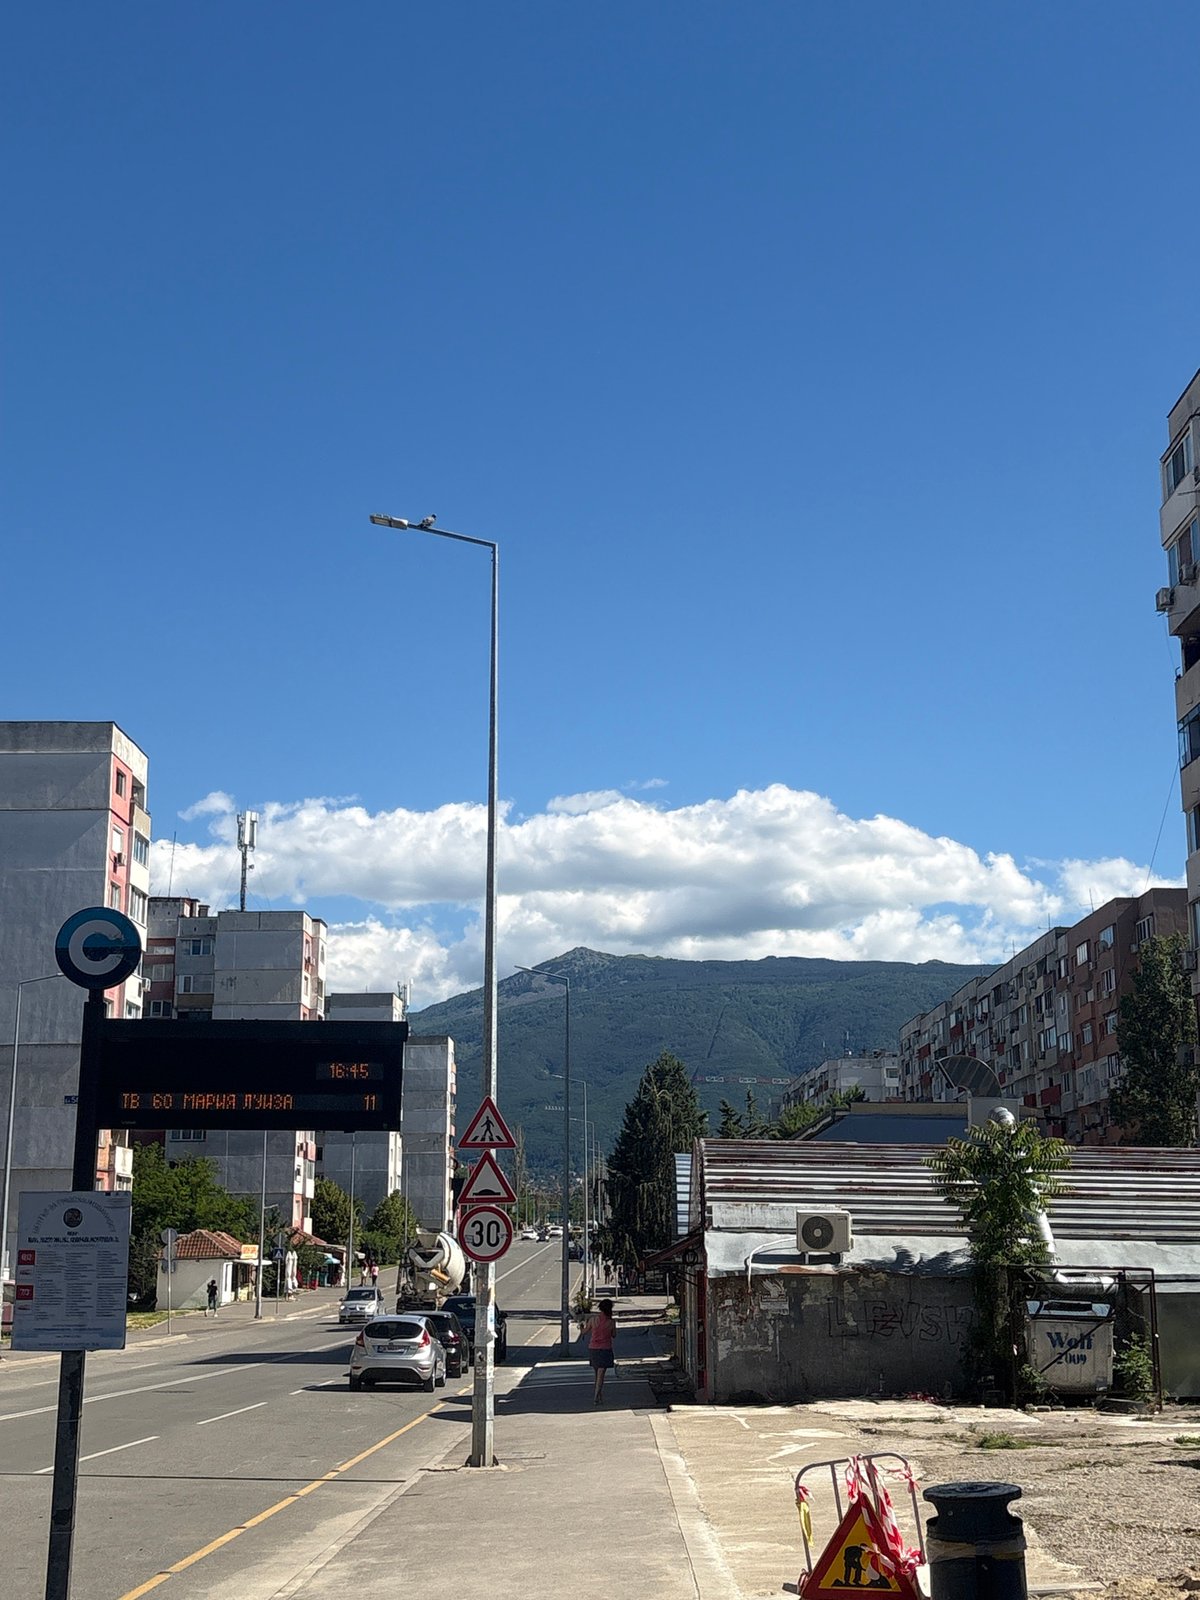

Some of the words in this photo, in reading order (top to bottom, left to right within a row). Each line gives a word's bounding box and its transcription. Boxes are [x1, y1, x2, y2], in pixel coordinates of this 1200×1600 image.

[329, 1063, 369, 1079] 16:45
[122, 1093, 140, 1109] ТВ
[152, 1093, 173, 1109] 60
[183, 1093, 236, 1109] МАРИЯ
[242, 1094, 294, 1110] ЛУИЗА
[364, 1095, 377, 1111] 11
[471, 1220, 501, 1247] 30
